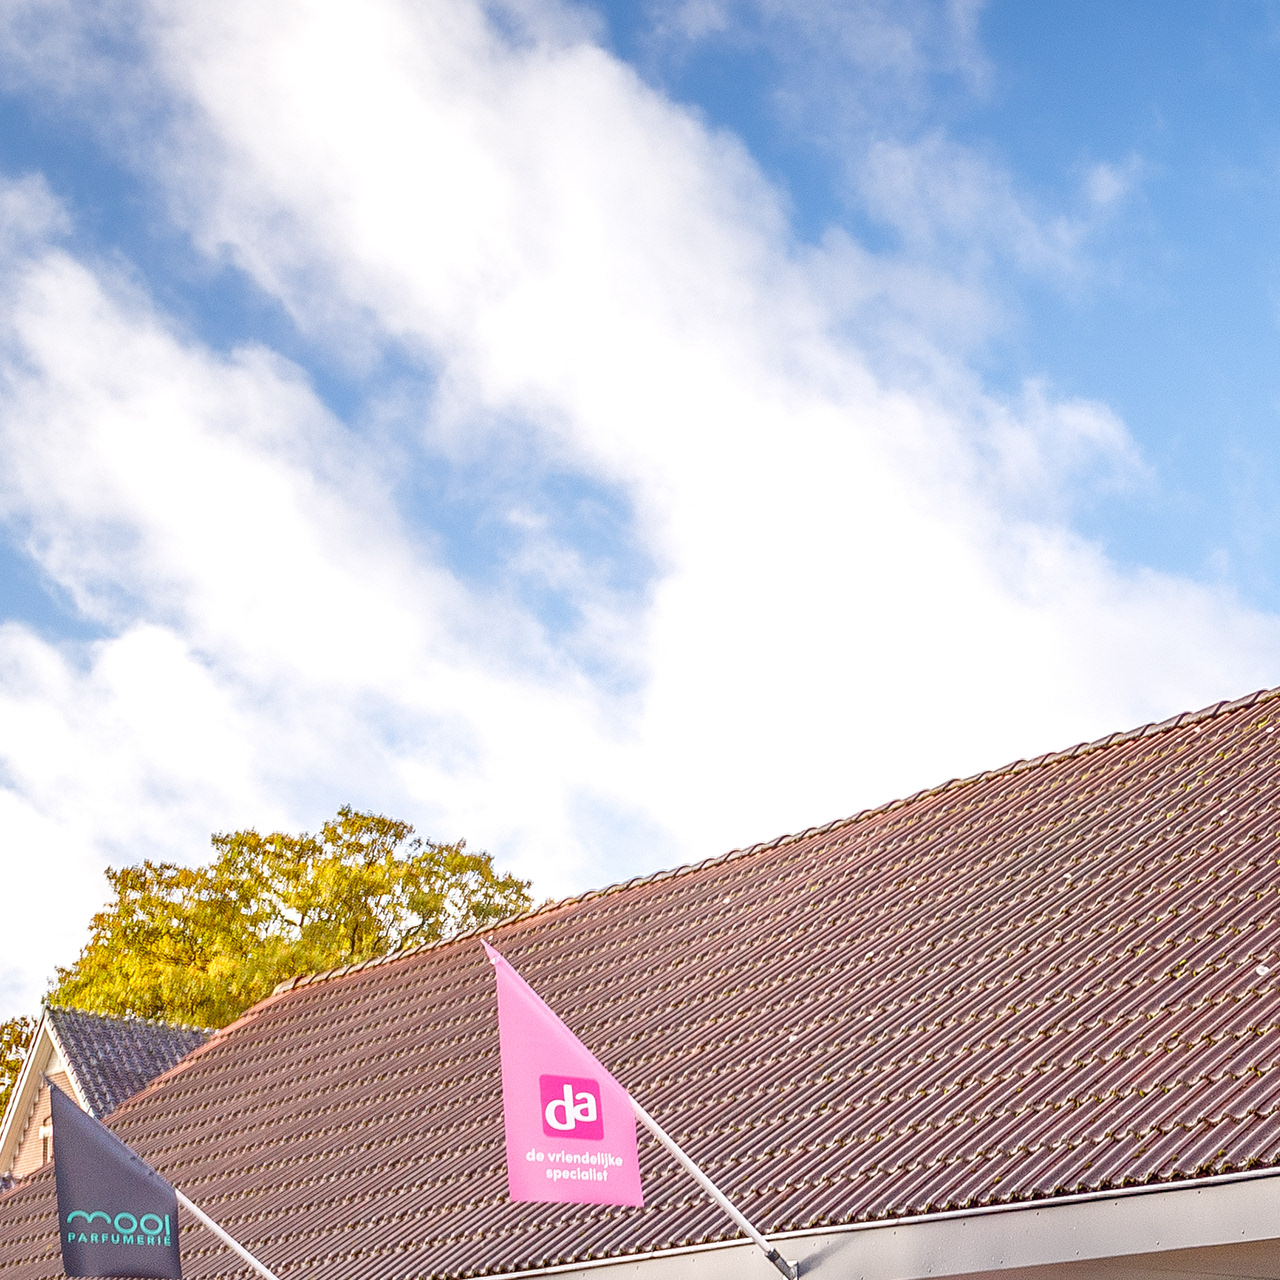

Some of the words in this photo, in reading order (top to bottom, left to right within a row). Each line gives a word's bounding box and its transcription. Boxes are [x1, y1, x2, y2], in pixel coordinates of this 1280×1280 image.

[545, 1083, 598, 1131] da
[525, 1148, 545, 1162] de
[547, 1150, 623, 1169] vriendelijke
[545, 1168, 609, 1182] specialist
[67, 1232, 172, 1247] PARFUMERIE
